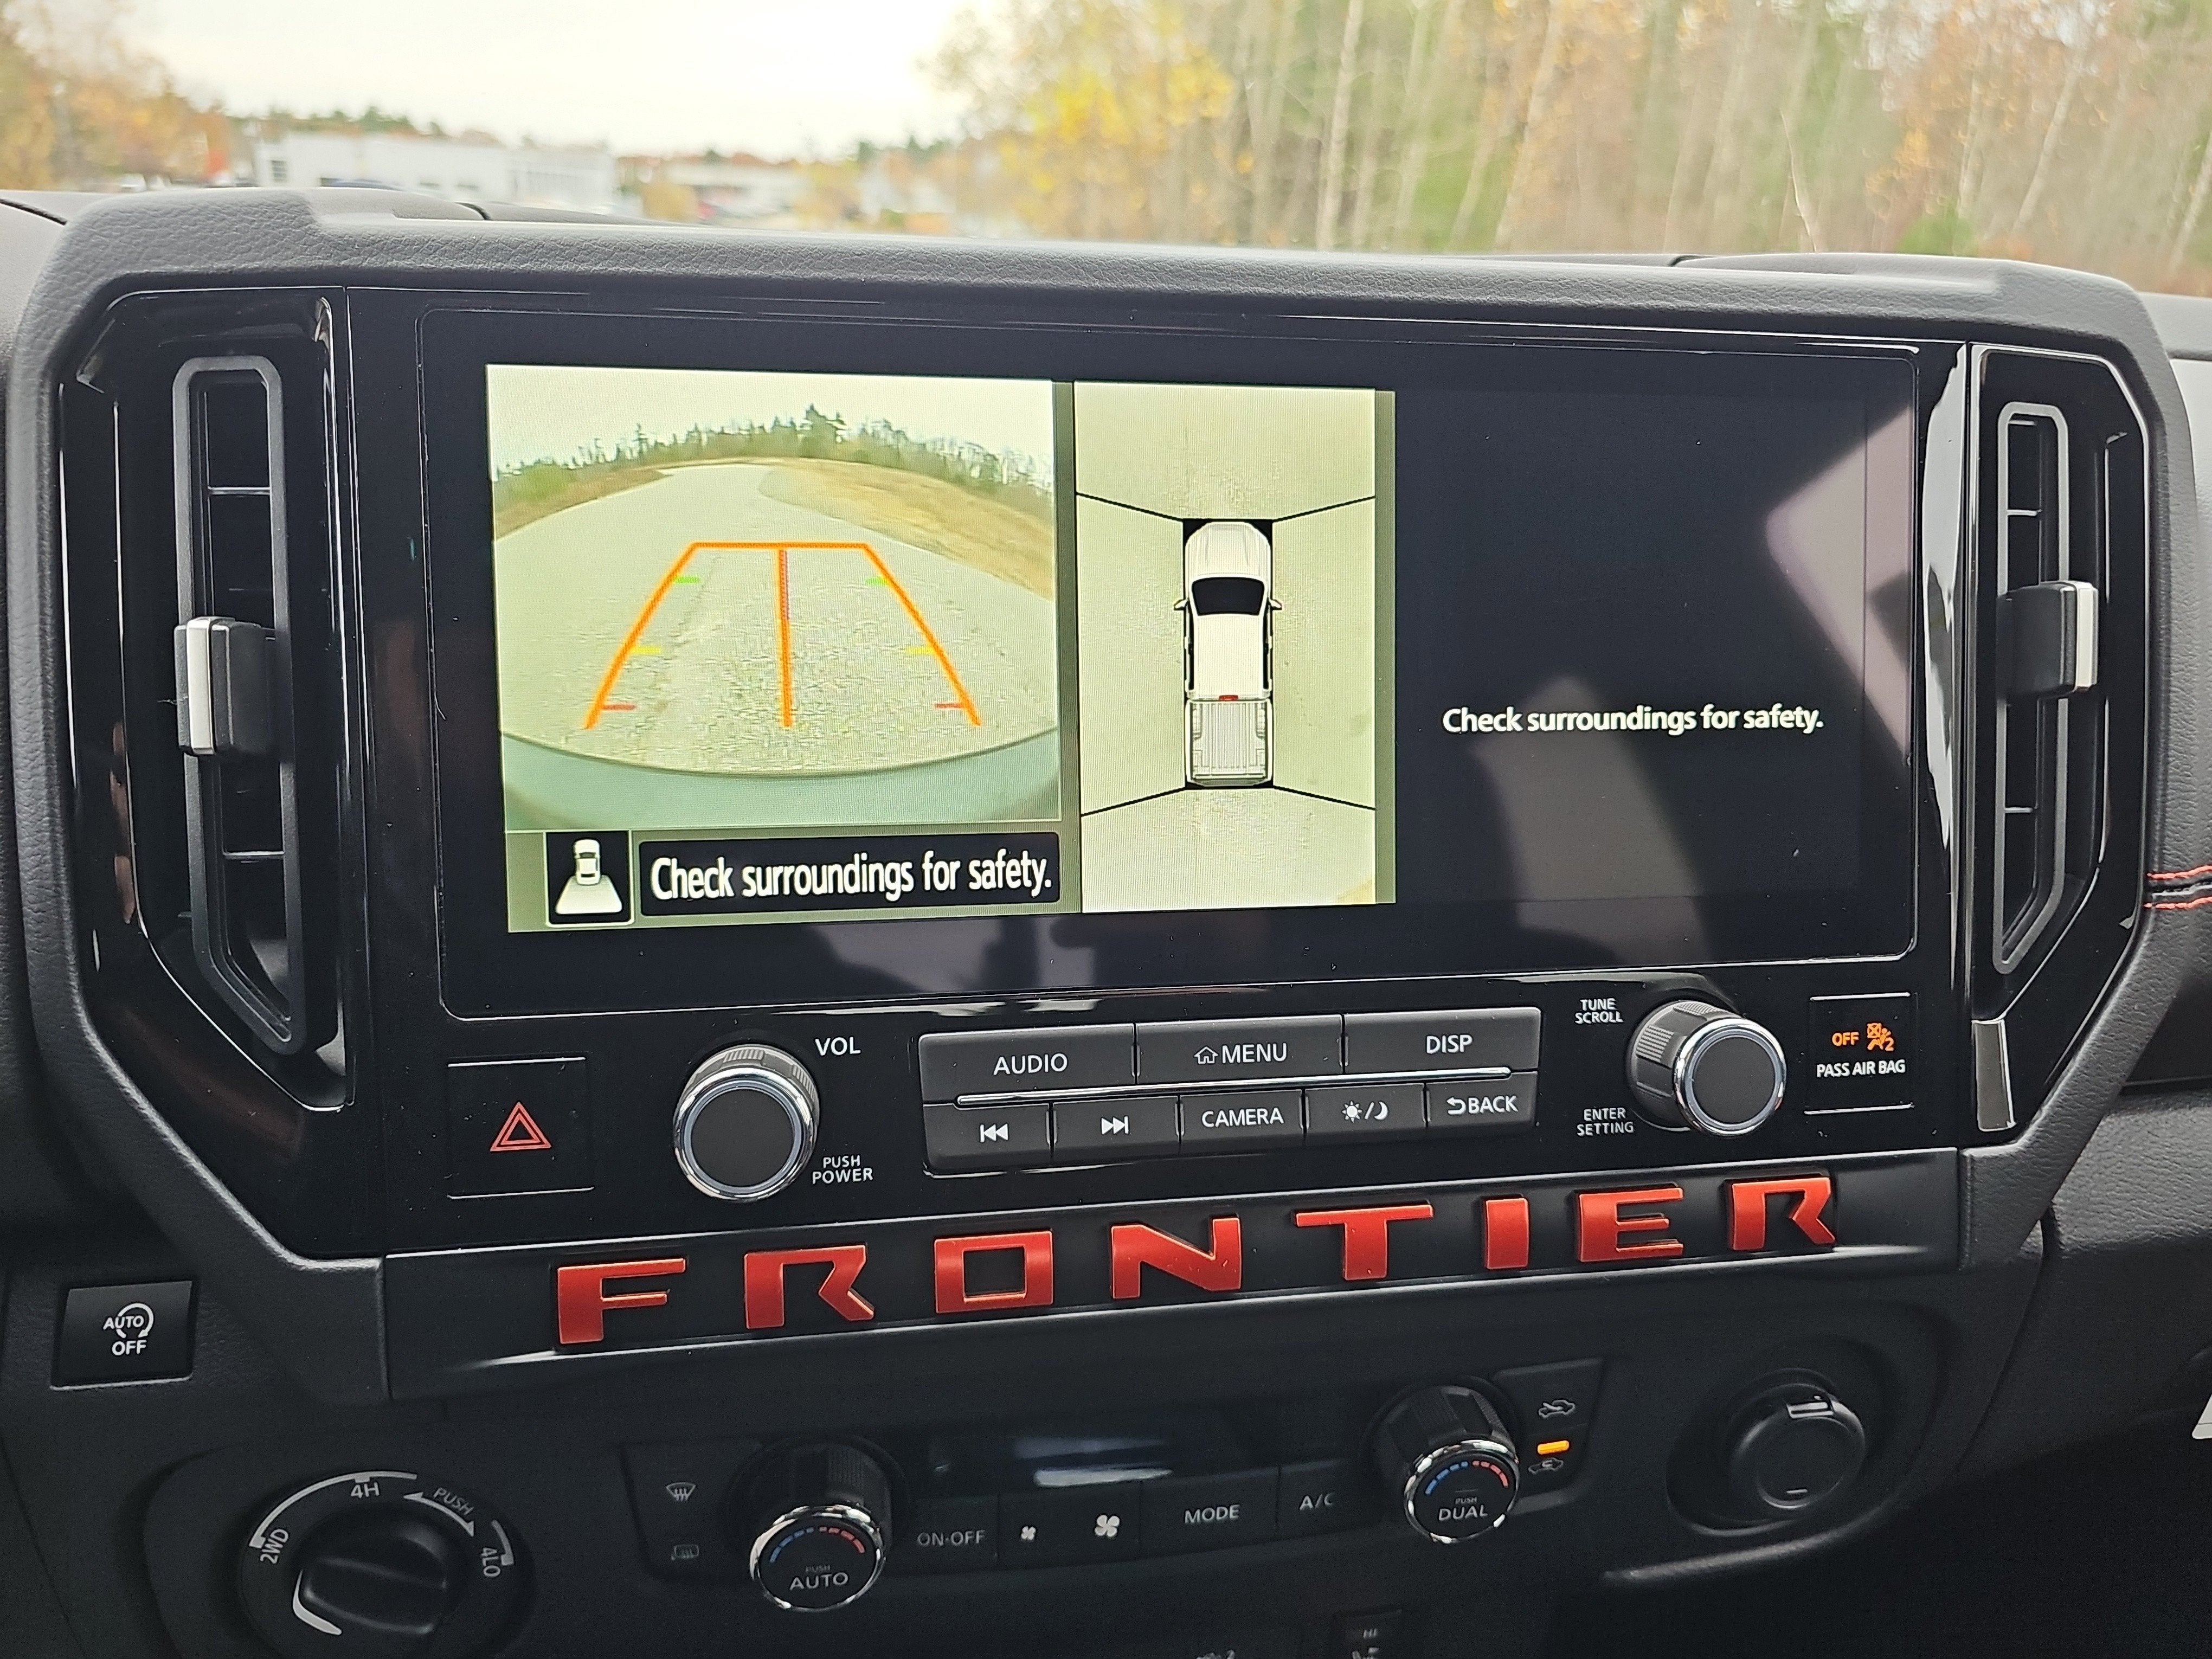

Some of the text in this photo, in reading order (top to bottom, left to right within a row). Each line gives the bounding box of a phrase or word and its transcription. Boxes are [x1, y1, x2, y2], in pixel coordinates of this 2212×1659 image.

[1442, 702, 1825, 736] Check surroundings for safety.
[651, 847, 1053, 901] Check surroundings for safety.
[1580, 998, 1616, 1011] TUNE
[1574, 1011, 1624, 1025] SCROLL
[815, 1037, 861, 1056] VOL
[1425, 1034, 1473, 1054] DISP
[1831, 1031, 1860, 1047] OFF
[1221, 1043, 1288, 1064] MENU
[993, 1052, 1068, 1076] AUDIO
[1816, 1059, 1906, 1078] PASS AIR BAG
[1468, 1095, 1519, 1115] BACK
[1201, 1107, 1284, 1128] CAMERA
[1583, 1107, 1626, 1122] ENTER
[1577, 1121, 1634, 1137] SETTING
[822, 1154, 861, 1169] PUSH
[812, 1167, 874, 1185] POWER
[557, 1176, 1836, 1345] FRONTIER
[102, 1314, 145, 1330] AUTO
[111, 1339, 147, 1356] OFF
[350, 1482, 380, 1499] 4H
[433, 1487, 474, 1516] PUSH
[1299, 1492, 1335, 1510] A/C
[1455, 1497, 1478, 1505] PUSH
[1184, 1504, 1240, 1523] MODE
[1438, 1504, 1488, 1521] DUAL
[259, 1527, 290, 1565] 2WD
[480, 1546, 501, 1578] 4LO
[789, 1572, 849, 1590] AUTO
